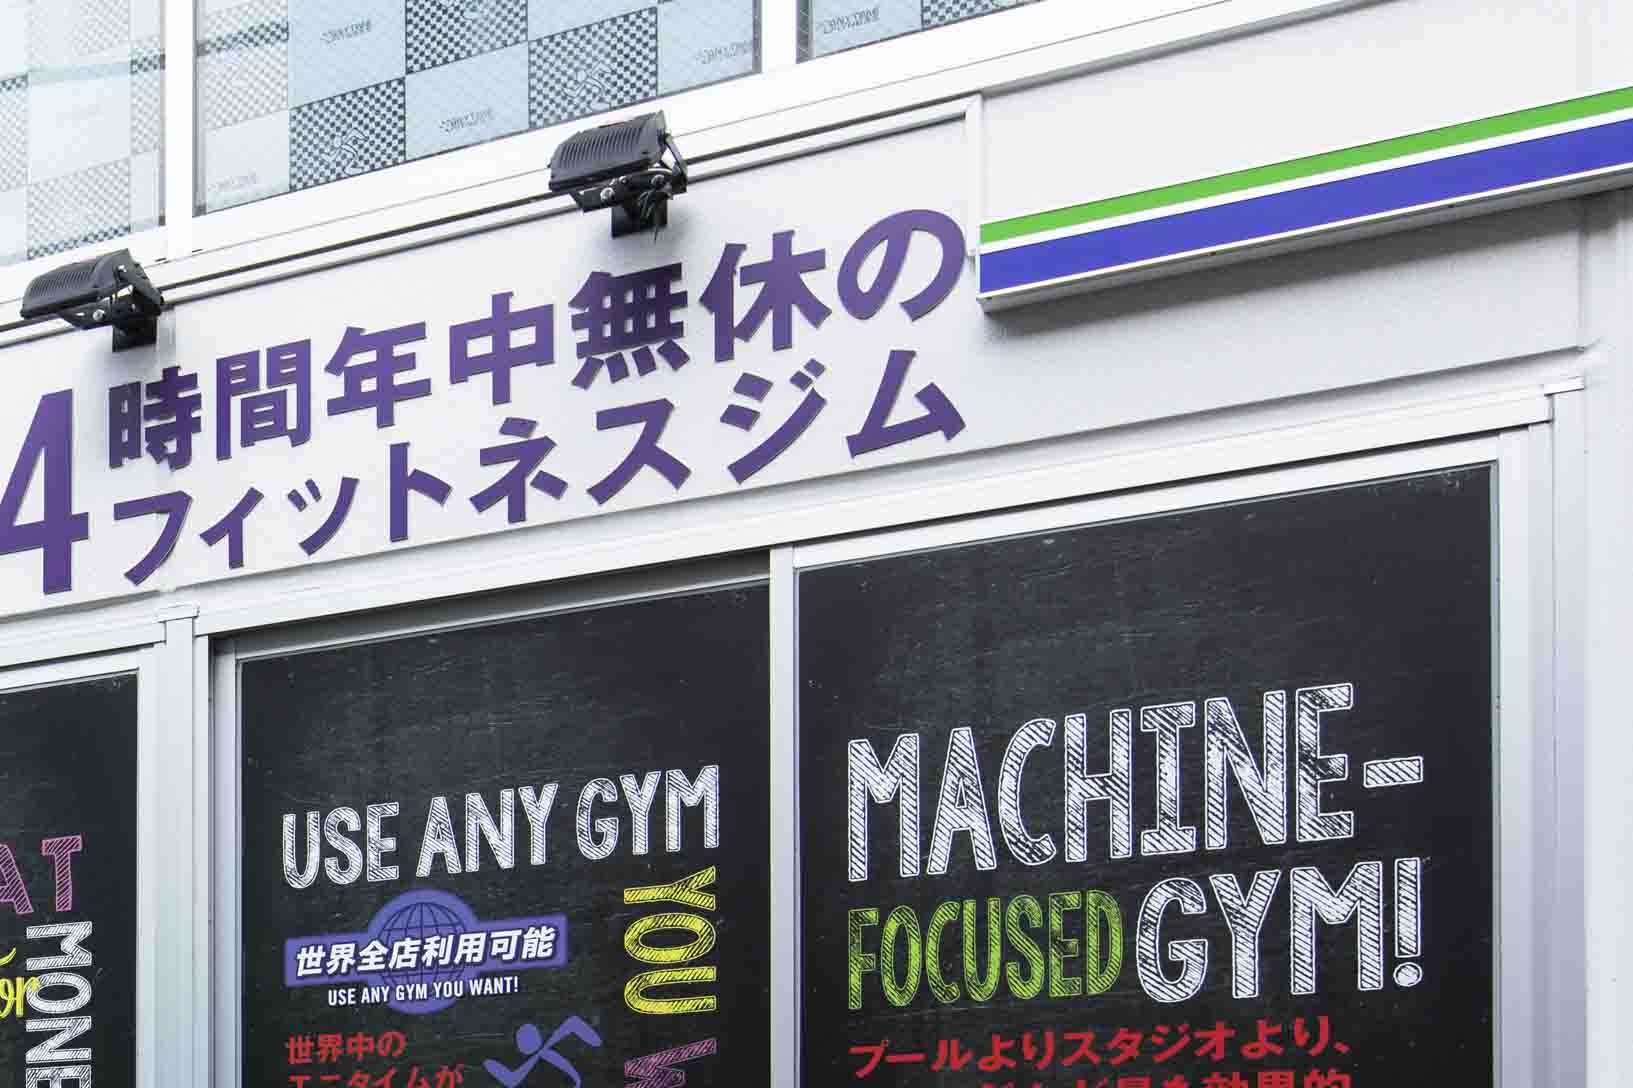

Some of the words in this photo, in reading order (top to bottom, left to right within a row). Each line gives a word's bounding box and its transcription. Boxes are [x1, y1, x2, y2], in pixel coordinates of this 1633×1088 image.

[111, 350, 970, 586] フィットネスジム
[282, 801, 400, 889] USE
[416, 782, 559, 877] ANY
[576, 765, 719, 860] GYM
[848, 683, 1424, 882] MACHINE-
[297, 925, 557, 977] 世界全店利用可能
[328, 988, 356, 1006] USE
[361, 986, 390, 1004] ANY
[395, 983, 428, 1001] GYM
[433, 980, 464, 998] YOU
[469, 976, 519, 996] WANT!
[624, 866, 717, 1015] YOU
[848, 889, 1123, 1010] FOCUSED
[1135, 857, 1424, 1003] GYM!
[285, 1031, 406, 1065] 世界中の
[848, 1016, 1351, 1081] プールよりスタジオより、
